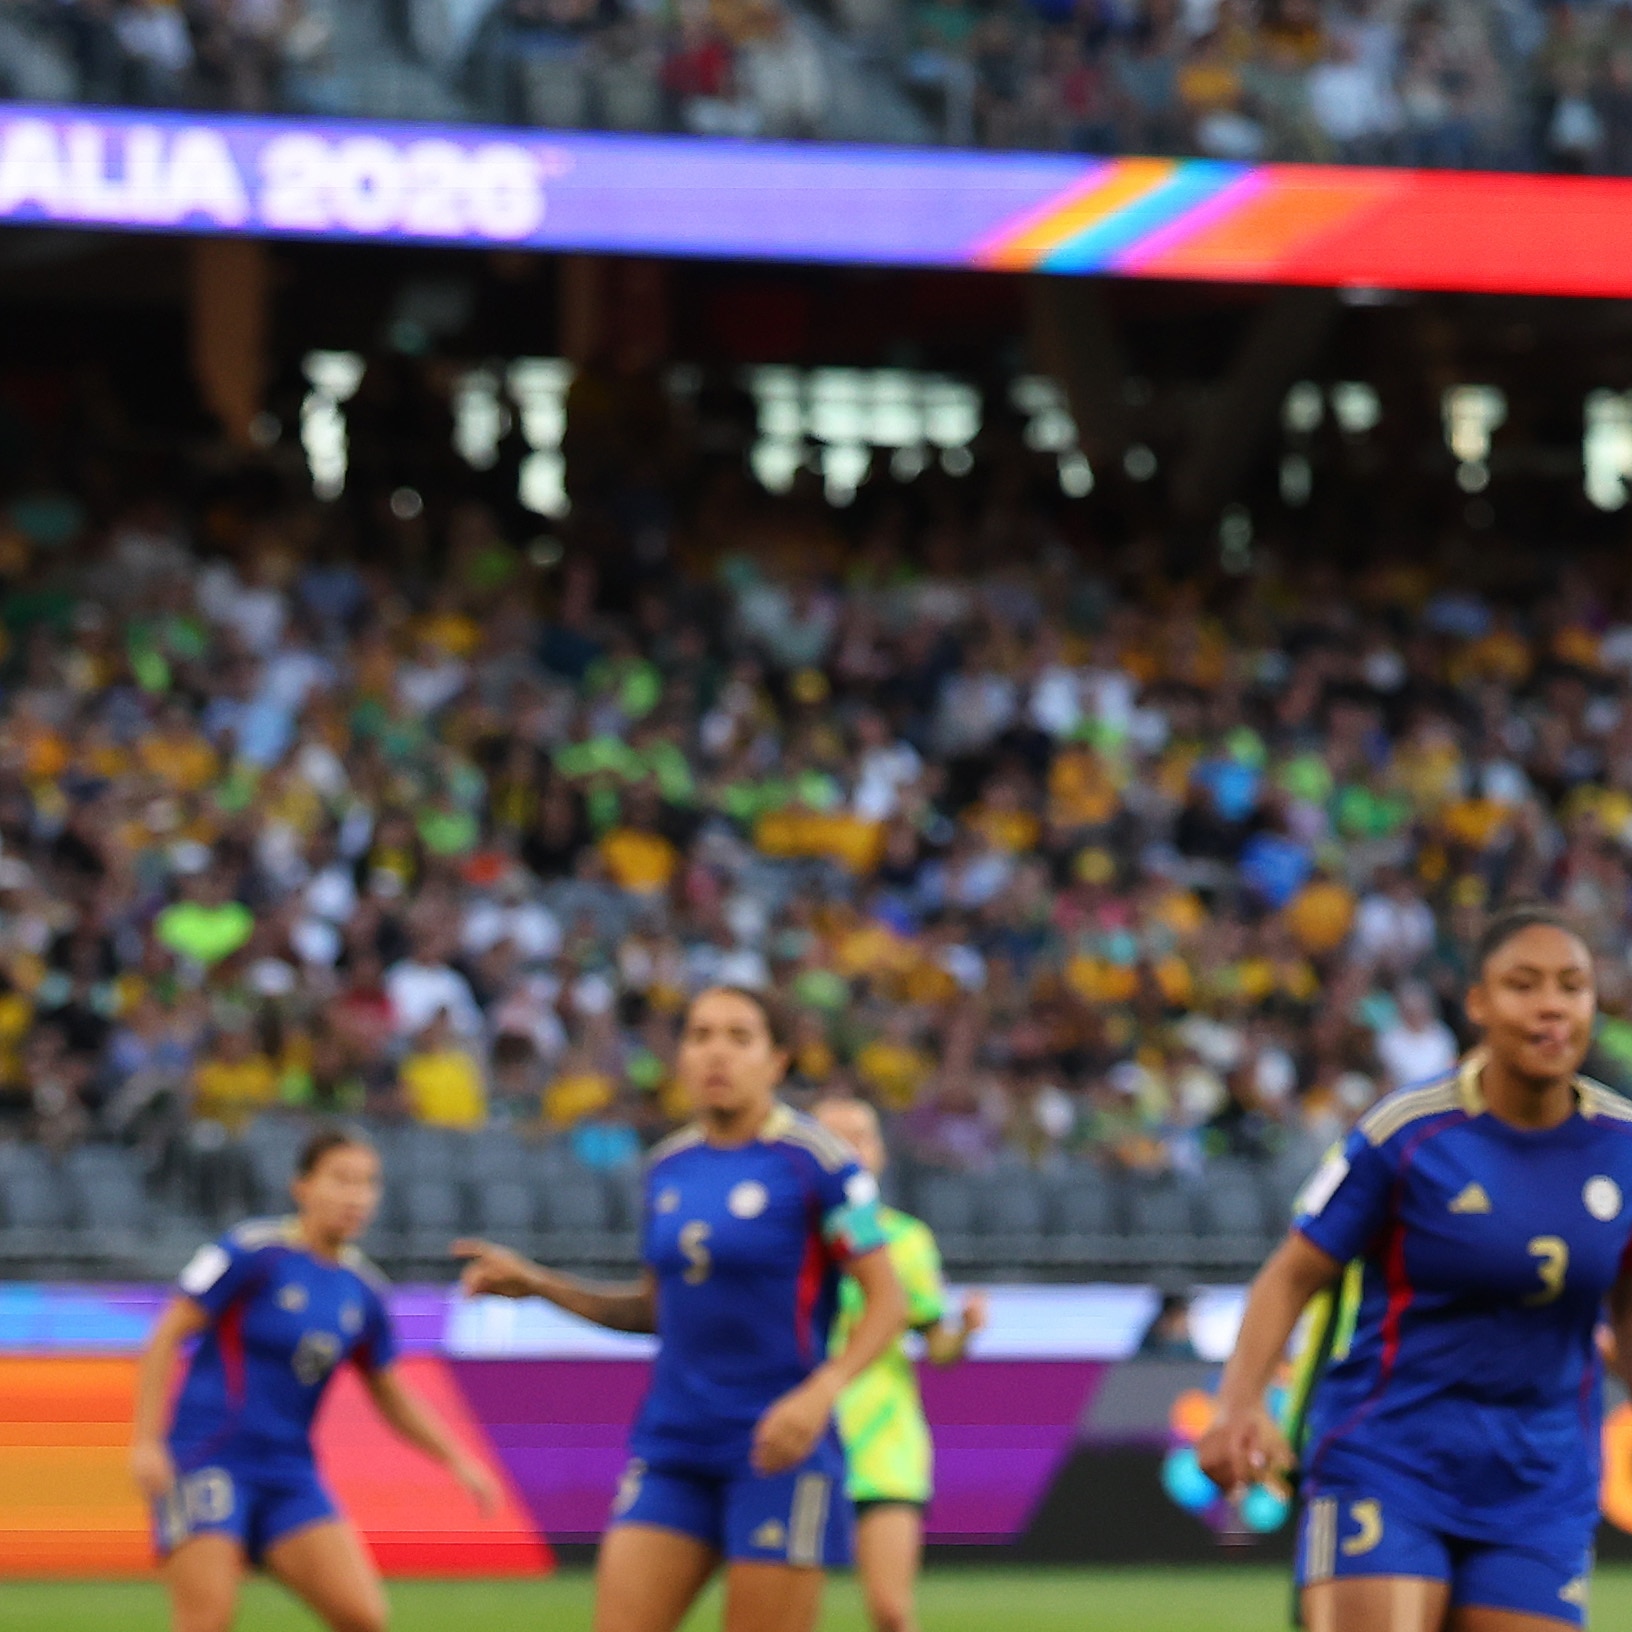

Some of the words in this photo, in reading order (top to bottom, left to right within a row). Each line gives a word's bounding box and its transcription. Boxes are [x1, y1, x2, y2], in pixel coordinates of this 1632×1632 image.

[259, 130, 548, 242] 2026
[677, 1218, 713, 1286] 5
[1522, 1234, 1570, 1307] 3
